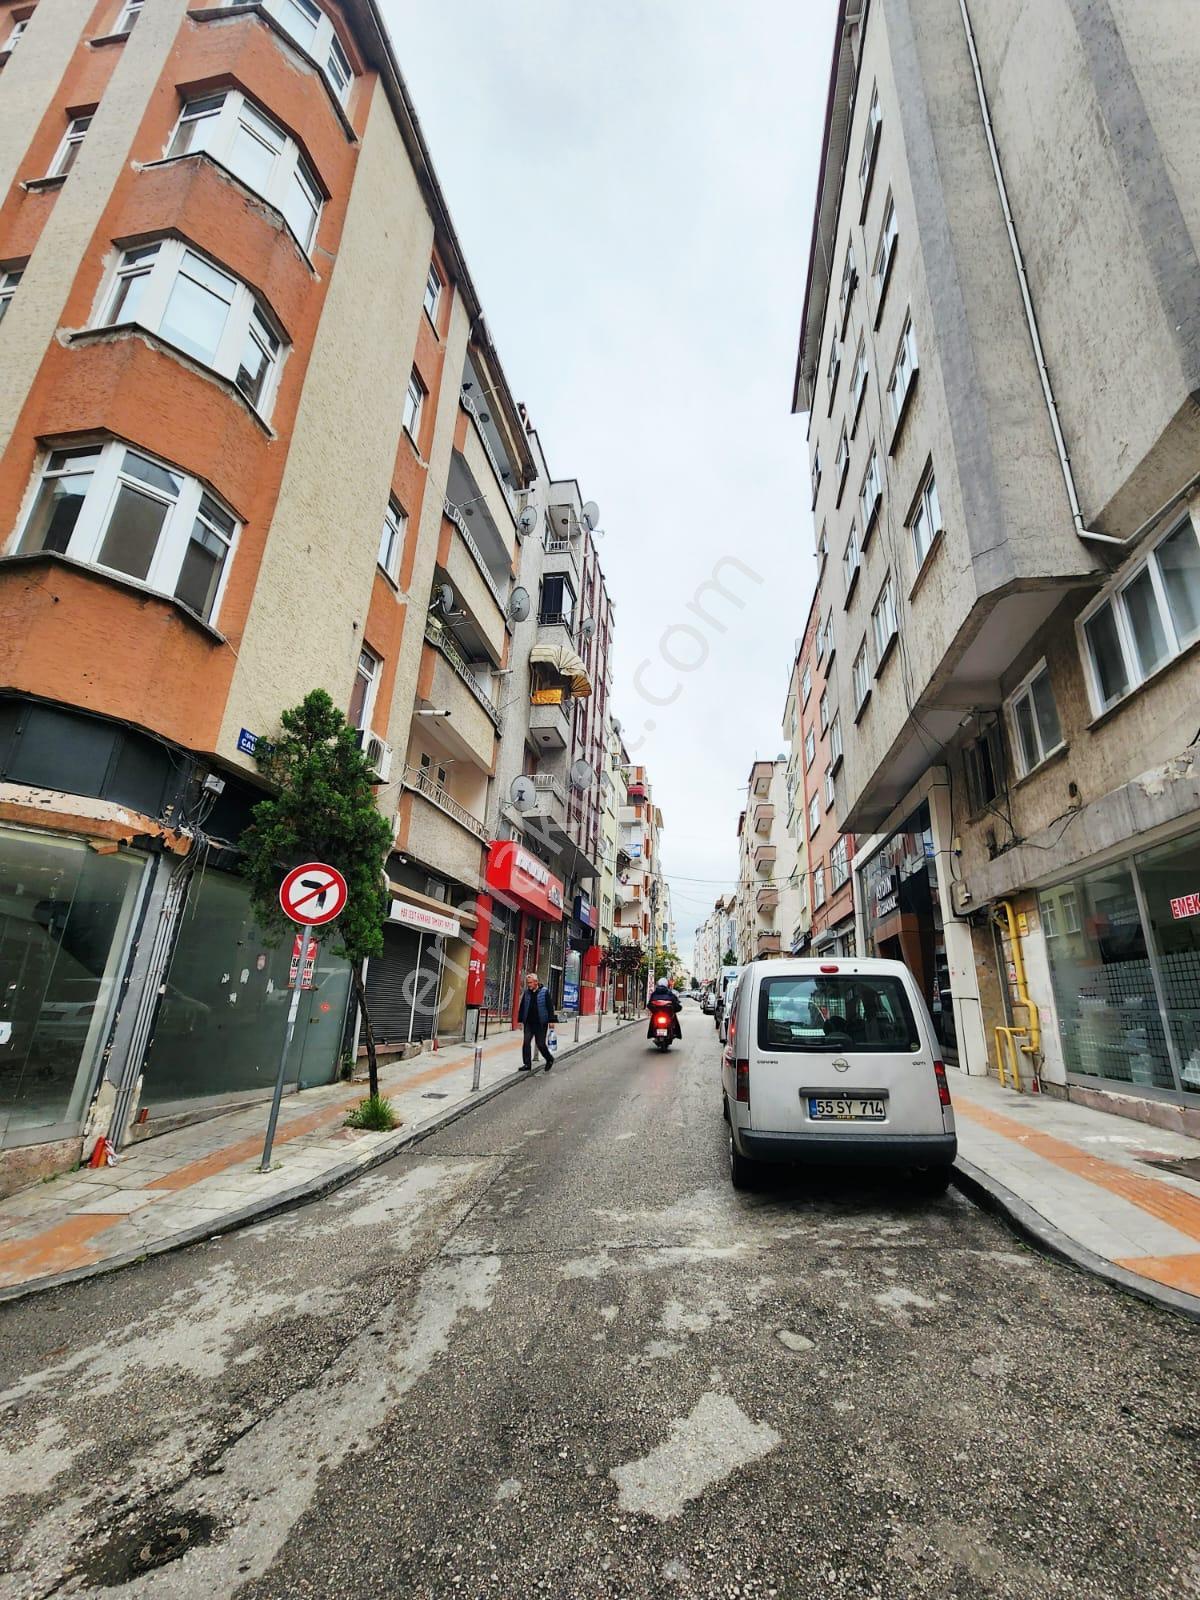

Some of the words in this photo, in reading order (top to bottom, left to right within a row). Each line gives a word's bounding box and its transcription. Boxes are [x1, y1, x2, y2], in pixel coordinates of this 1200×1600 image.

[817, 1100, 834, 1114] 55
[836, 1100, 853, 1114] SY
[860, 1101, 884, 1115] 714
